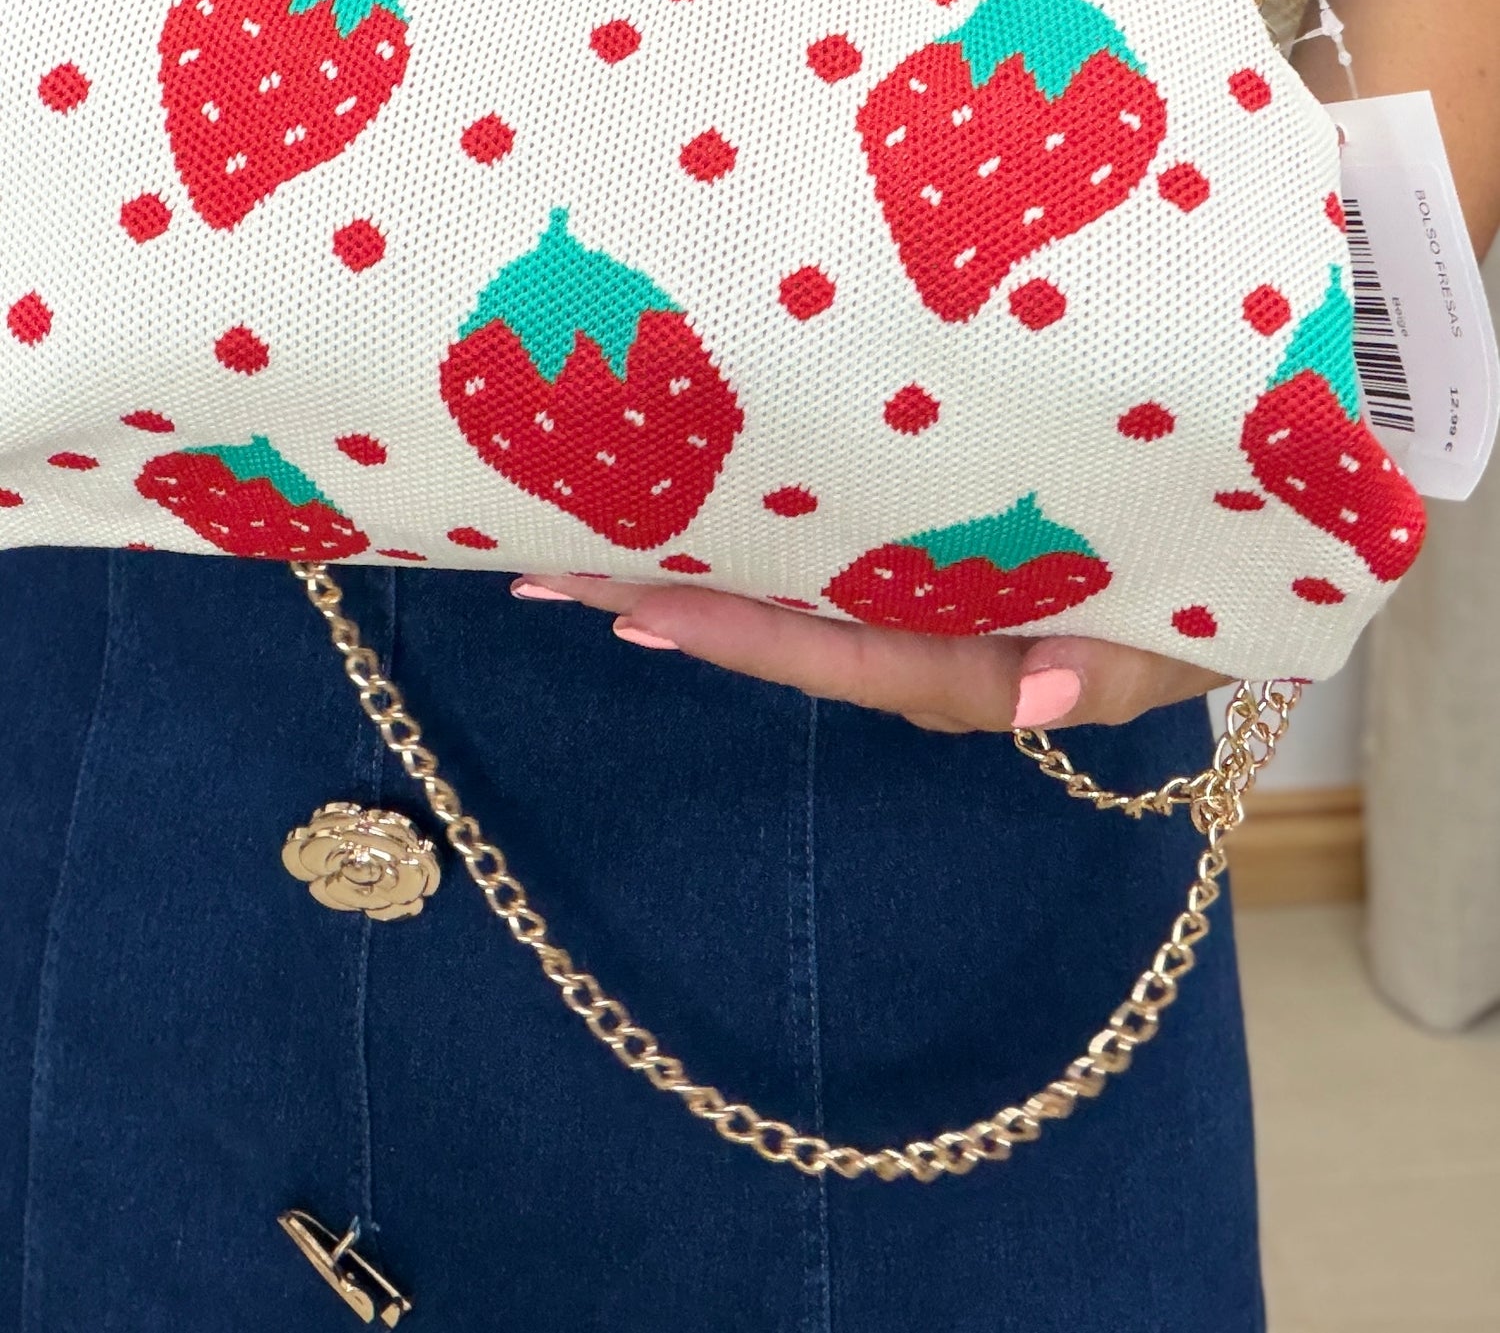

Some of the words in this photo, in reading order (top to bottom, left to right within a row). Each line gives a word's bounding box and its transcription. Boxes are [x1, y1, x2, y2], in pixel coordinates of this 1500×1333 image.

[1414, 189, 1441, 255] BOLSO
[1434, 261, 1463, 338] FRESAS
[1444, 441, 1453, 453] €
